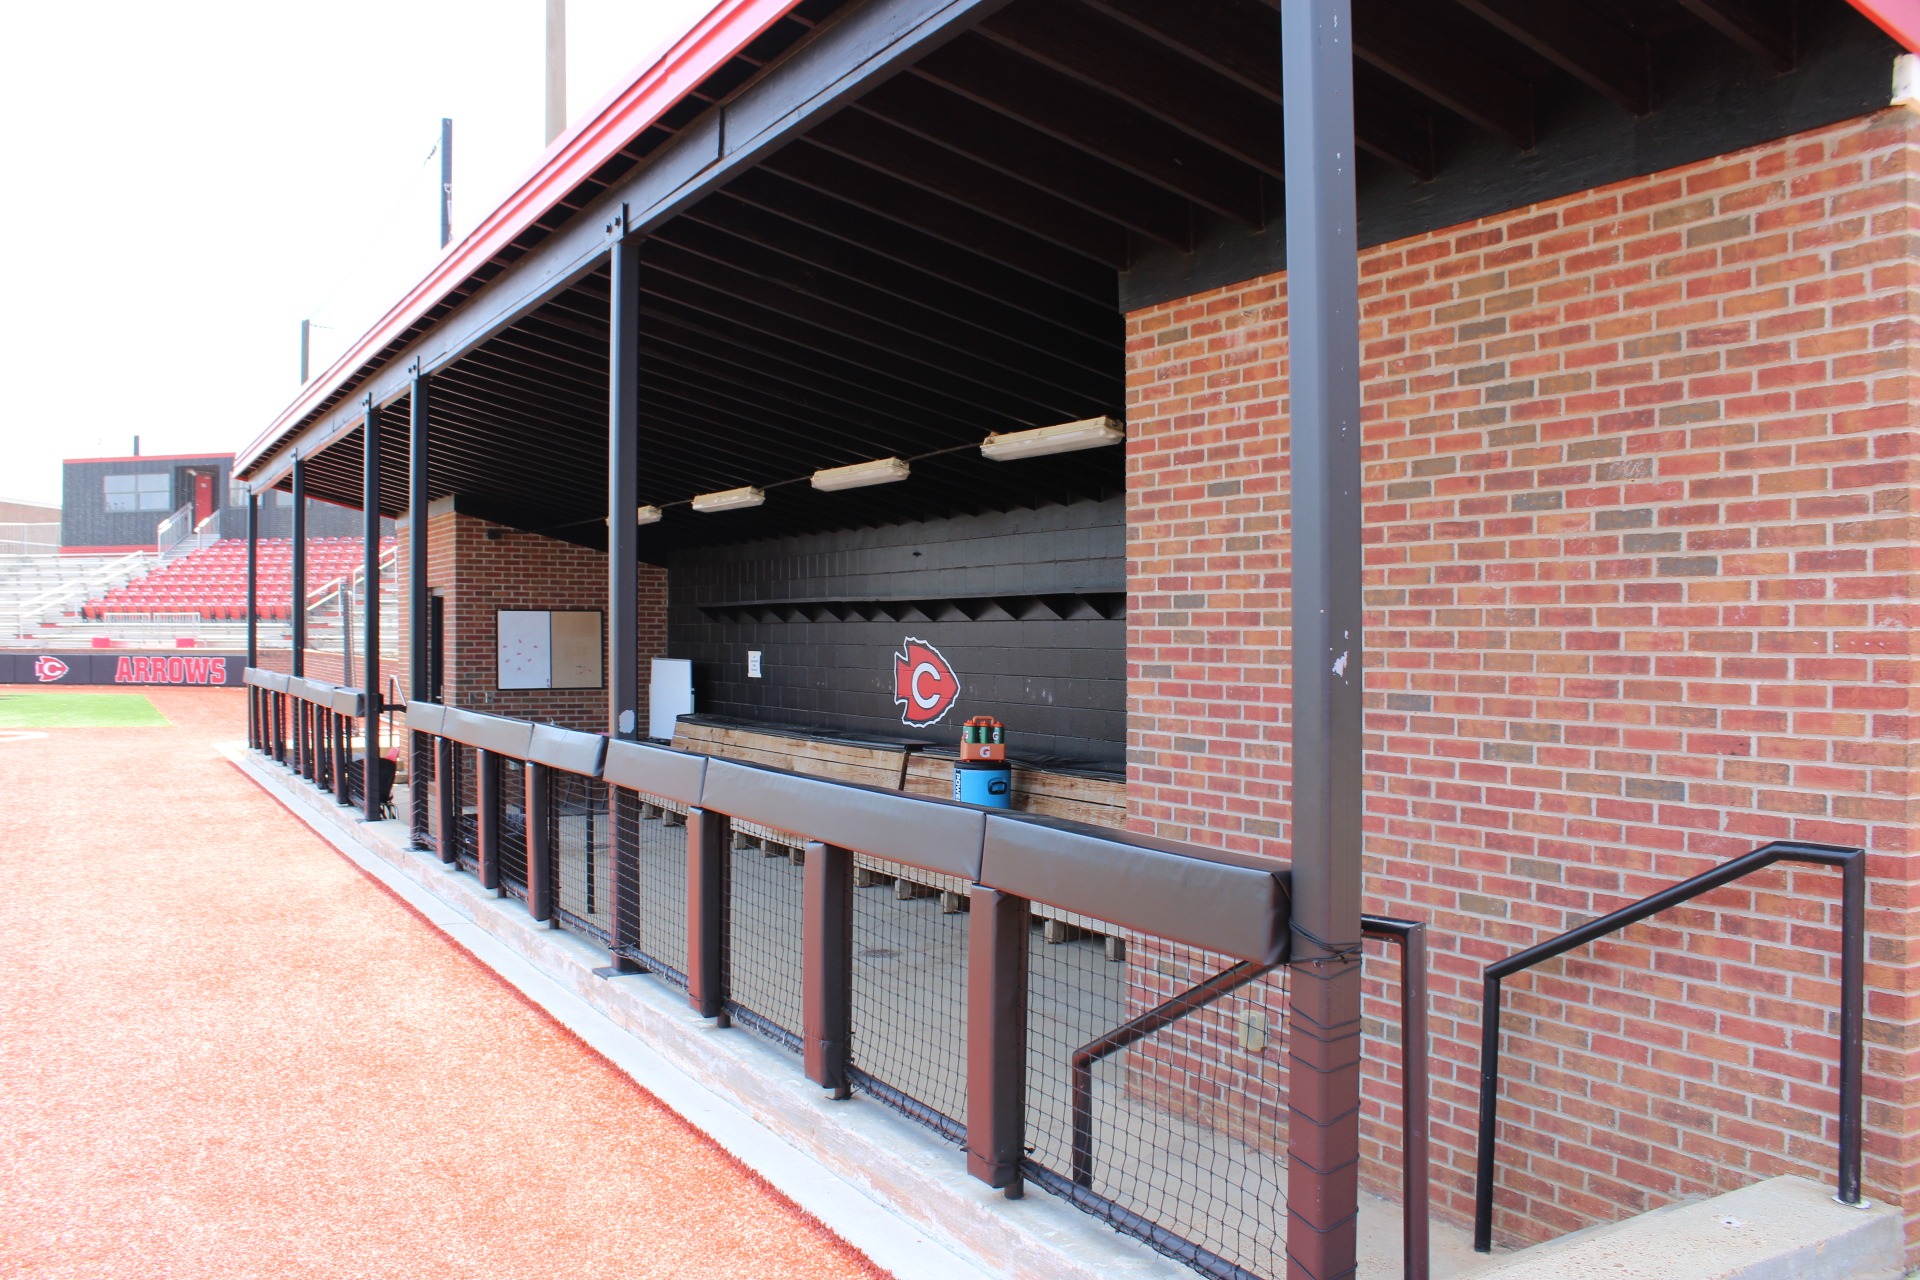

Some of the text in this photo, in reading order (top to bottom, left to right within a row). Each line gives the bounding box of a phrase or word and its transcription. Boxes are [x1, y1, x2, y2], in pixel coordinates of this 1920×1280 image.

[43, 662, 62, 676] C
[115, 656, 226, 684] ARROWS
[912, 663, 940, 708] C
[980, 745, 990, 758] G
